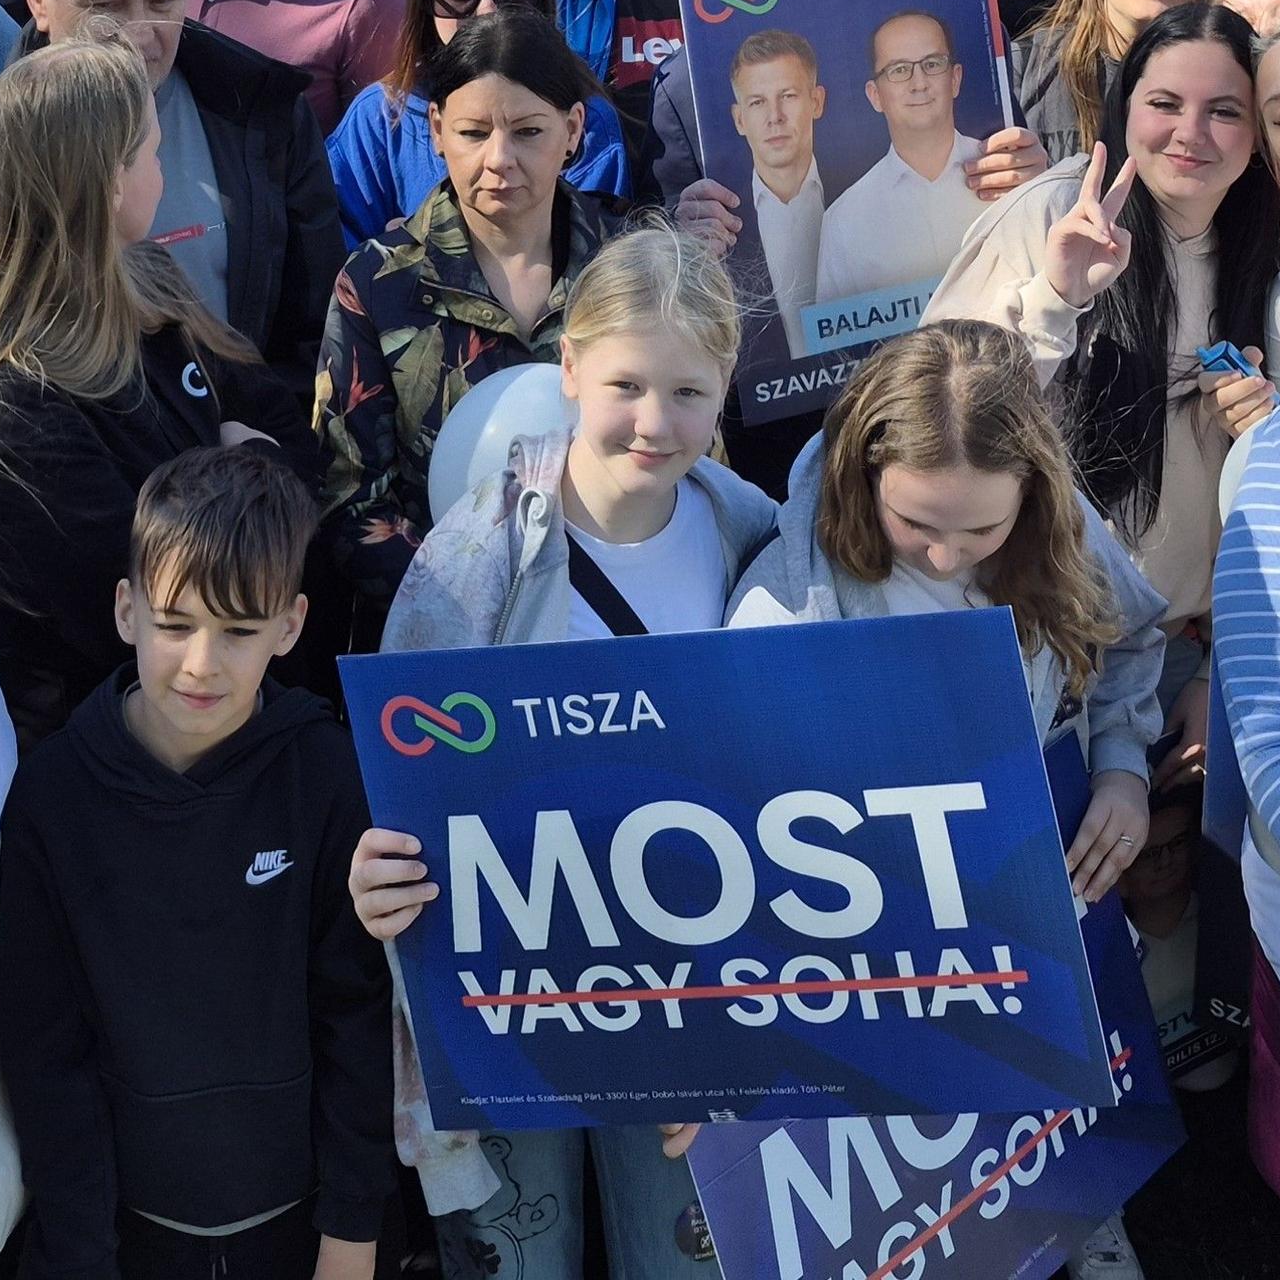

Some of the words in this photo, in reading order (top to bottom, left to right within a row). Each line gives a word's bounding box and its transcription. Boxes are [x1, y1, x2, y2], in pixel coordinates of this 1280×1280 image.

[817, 296, 920, 339] BALAJTI
[511, 689, 666, 738] TISZA
[254, 850, 287, 871] NIKE
[447, 782, 987, 953] MOST
[458, 961, 693, 1036] VAGY
[720, 945, 1025, 1029] SOHA!
[606, 1091, 628, 1100] 3300
[652, 1089, 676, 1099] Dobó
[704, 1089, 724, 1097] utca
[800, 1084, 821, 1094] Tóth
[822, 1083, 846, 1093] Péter
